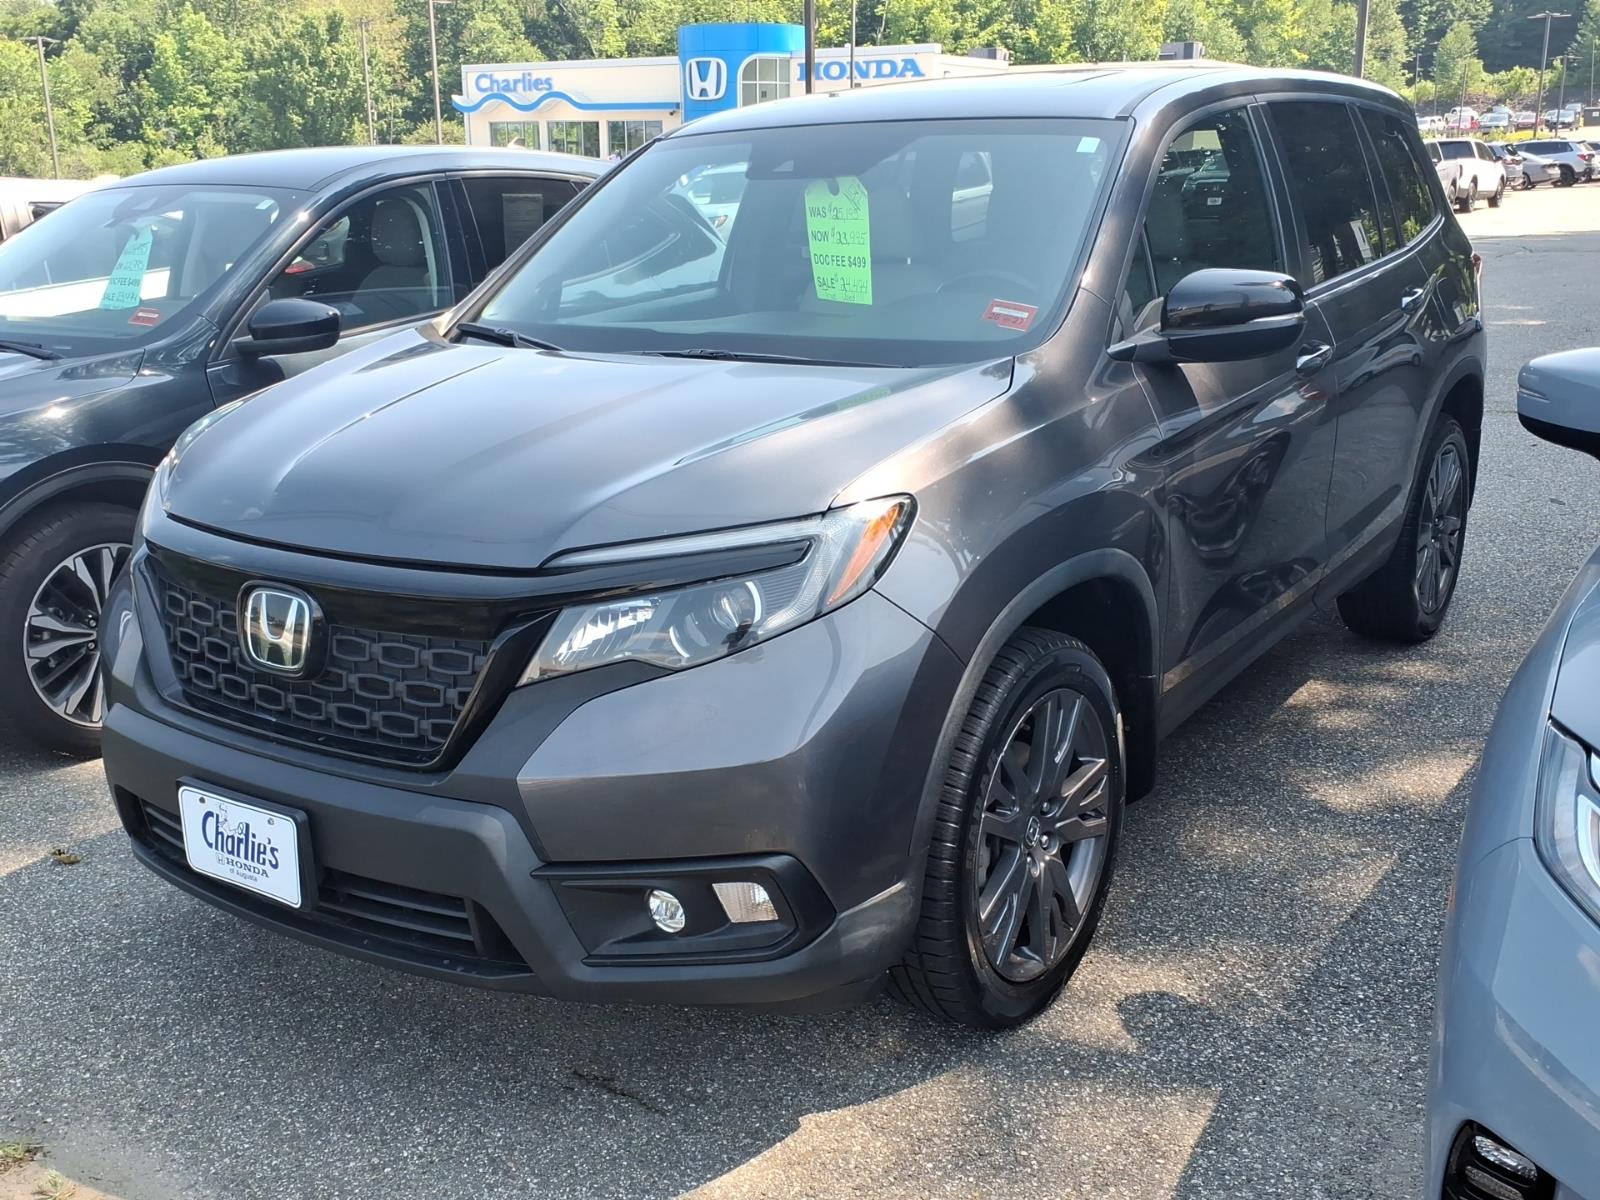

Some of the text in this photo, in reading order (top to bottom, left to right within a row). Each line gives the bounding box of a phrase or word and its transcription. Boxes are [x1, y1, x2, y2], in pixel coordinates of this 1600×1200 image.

[797, 58, 925, 81] HONDA
[475, 72, 553, 92] Charlies
[808, 206, 827, 218] WAS
[811, 230, 830, 243] NOW
[813, 253, 867, 268] DOC FEE $499
[817, 276, 836, 289] SALE
[202, 810, 279, 870] Charlie's
[226, 857, 270, 879] HONDA
